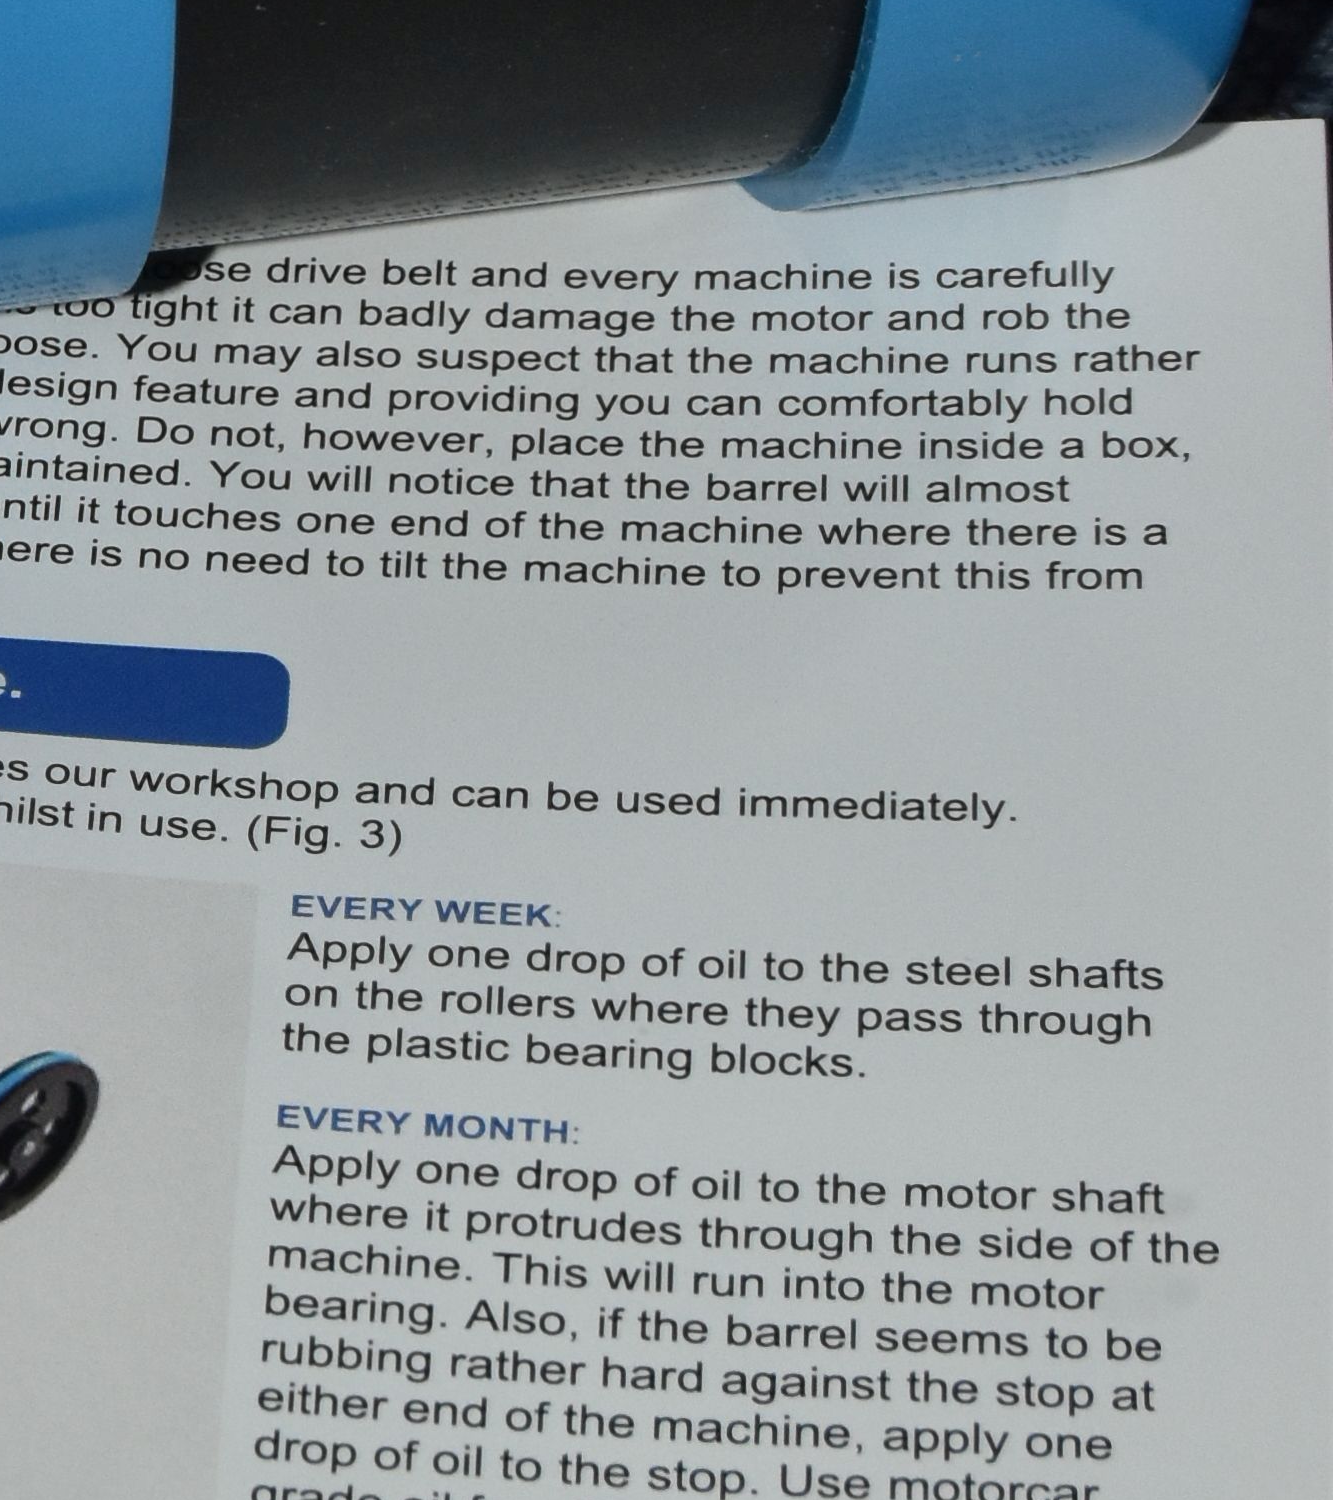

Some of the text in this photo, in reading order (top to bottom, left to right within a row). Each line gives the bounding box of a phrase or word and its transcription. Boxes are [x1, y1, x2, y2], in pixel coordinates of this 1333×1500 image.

[265, 255, 1116, 299] drive belt and every machine is carefully
[43, 762, 118, 790] our
[128, 767, 340, 811] workshop
[354, 776, 436, 807] and
[451, 784, 530, 810] can
[546, 780, 600, 814] be
[615, 786, 722, 817] used
[738, 786, 1017, 831] immediately.
[290, 893, 561, 928] EVERY WEEK:
[281, 1021, 866, 1081] the plastic bearing blocks.
[276, 1103, 579, 1145] EVERY MONTH:
